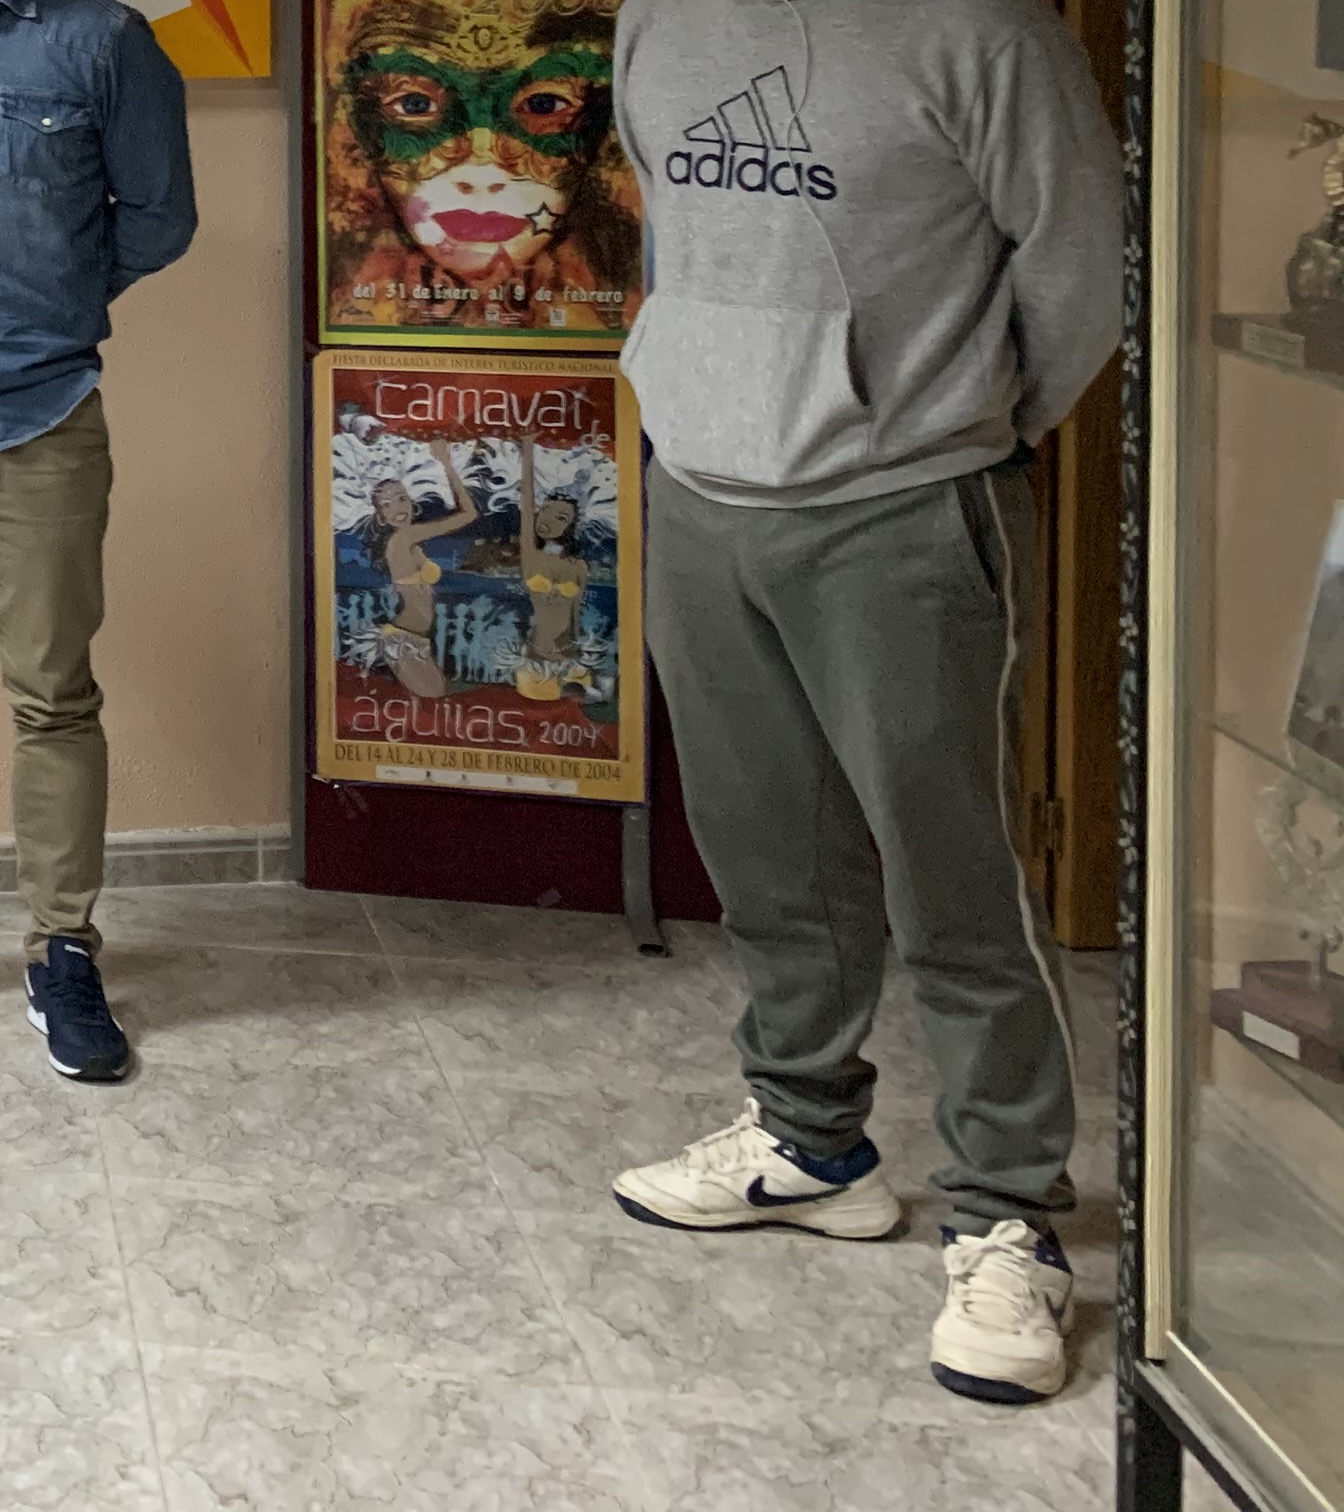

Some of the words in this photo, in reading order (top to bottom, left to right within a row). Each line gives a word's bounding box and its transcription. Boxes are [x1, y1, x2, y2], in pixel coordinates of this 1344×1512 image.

[666, 143, 838, 201] adidas
[353, 283, 376, 299] del
[385, 283, 407, 299] 31
[412, 284, 431, 300] de
[433, 285, 479, 301] Enero
[488, 285, 504, 301] al
[535, 286, 552, 302] de
[563, 287, 624, 303] febrero
[332, 355, 366, 366] FIESTA
[369, 356, 430, 368] DECLARADA
[434, 358, 448, 369] DE
[579, 420, 611, 448] de
[539, 721, 601, 748] 2004
[334, 743, 362, 761] DEL
[366, 746, 382, 762] 14
[383, 746, 404, 764] AL
[407, 748, 425, 765] 24
[427, 749, 438, 766] Y
[440, 750, 457, 768] 28
[462, 752, 482, 770] DE
[487, 753, 556, 776] FEBRERO
[561, 760, 580, 778] DE
[585, 762, 621, 781] 2004
